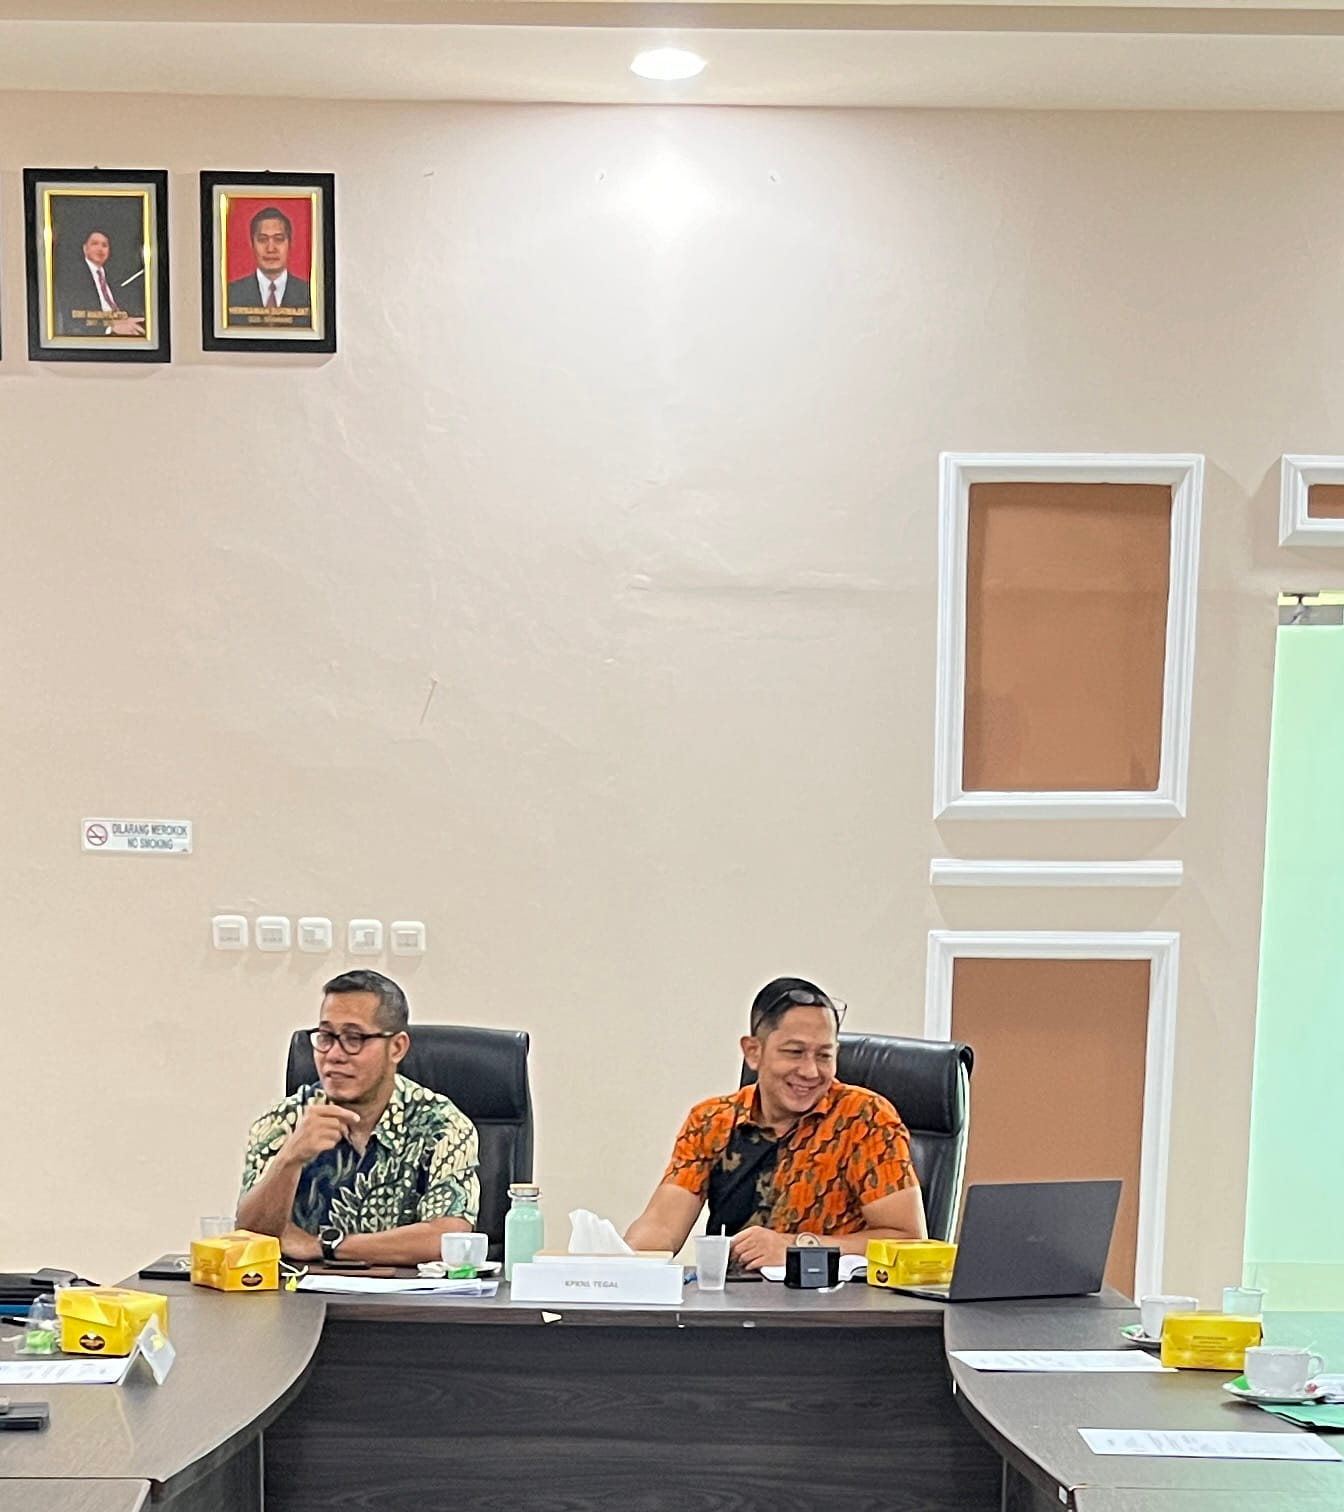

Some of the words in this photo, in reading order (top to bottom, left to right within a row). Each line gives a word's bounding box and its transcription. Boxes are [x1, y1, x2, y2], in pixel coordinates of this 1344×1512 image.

[112, 824, 149, 835] DILARANG
[151, 825, 187, 836] MEROKOK
[128, 838, 138, 848] NO
[140, 838, 173, 849] SMOKING
